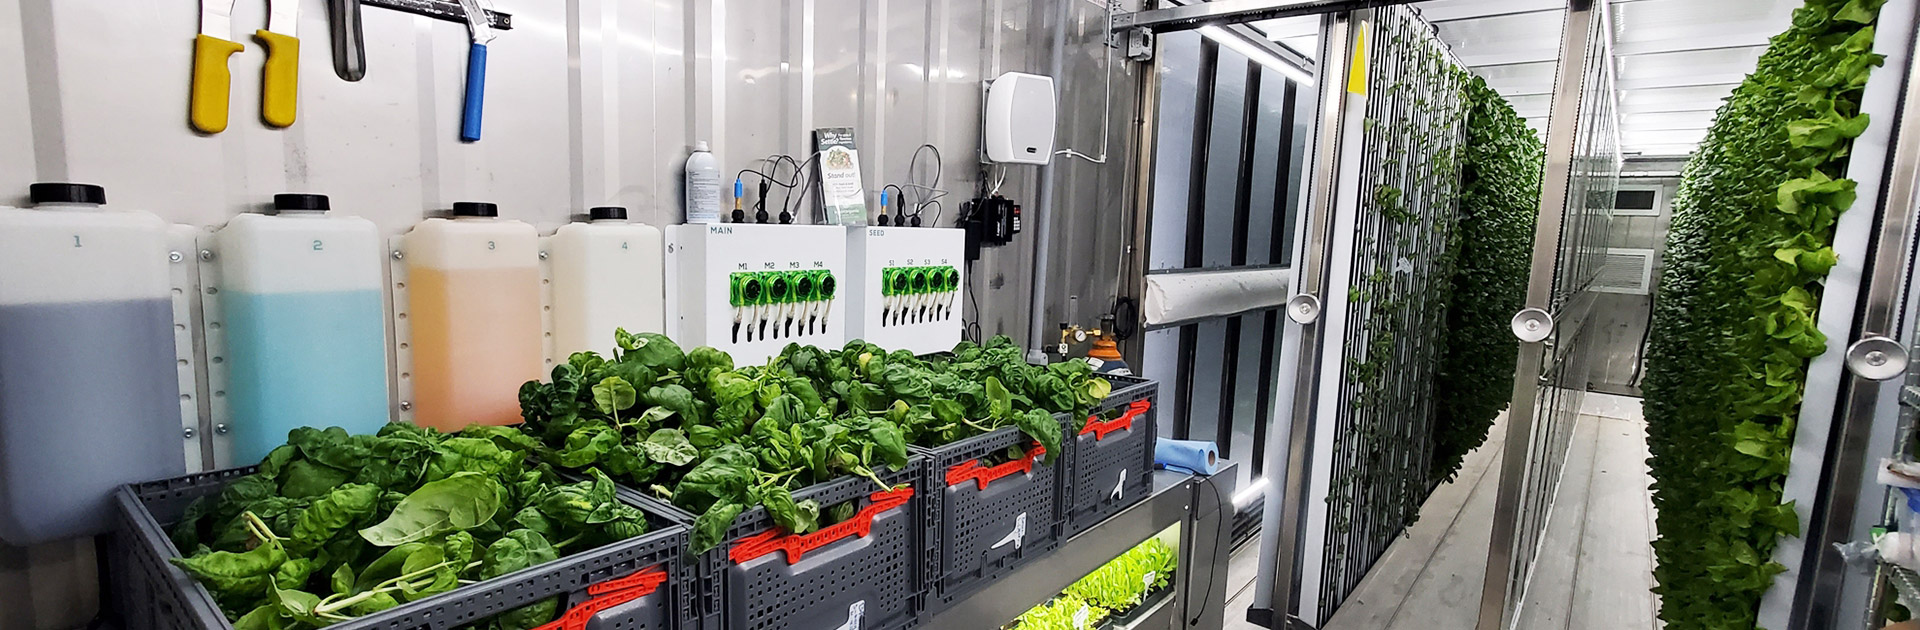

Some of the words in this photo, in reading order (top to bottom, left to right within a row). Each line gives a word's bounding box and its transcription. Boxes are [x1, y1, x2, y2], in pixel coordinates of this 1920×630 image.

[823, 132, 837, 140] Why
[710, 226, 733, 235] MAIN
[869, 229, 885, 237] SEED
[73, 235, 83, 248] 1
[313, 239, 323, 251] 2
[487, 240, 496, 250] 3
[621, 241, 628, 250] 4
[738, 262, 748, 270] M1
[789, 261, 800, 269] M3
[813, 260, 823, 268] M4
[906, 258, 914, 266] S2
[924, 258, 931, 266] S3
